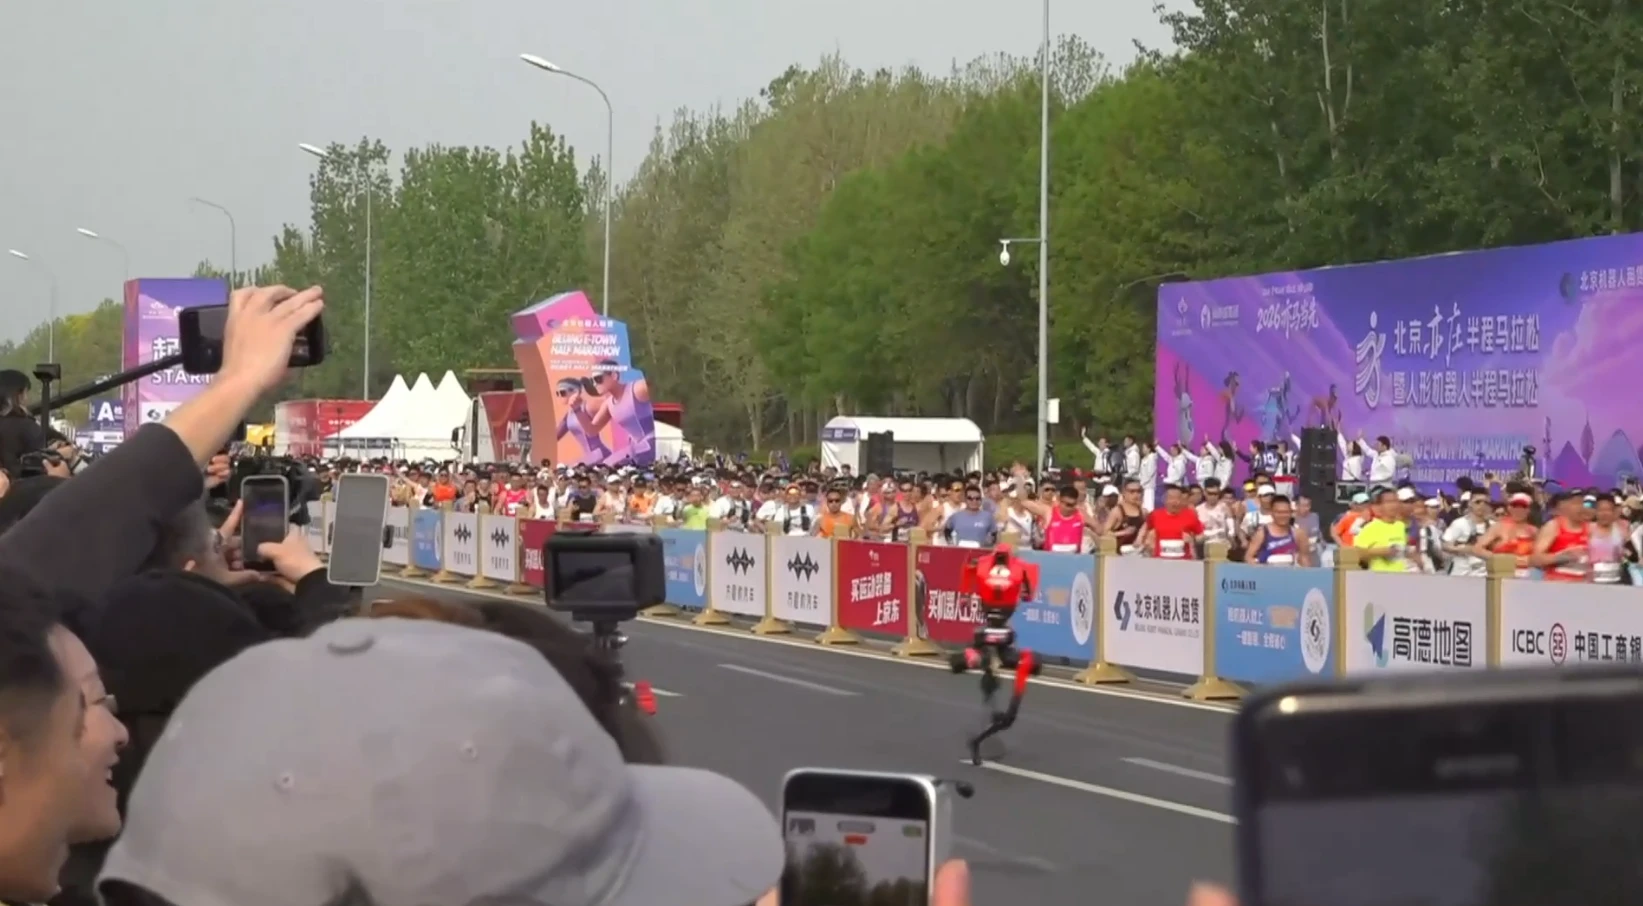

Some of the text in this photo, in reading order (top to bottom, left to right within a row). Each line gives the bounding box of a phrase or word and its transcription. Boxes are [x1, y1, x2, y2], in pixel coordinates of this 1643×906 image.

[573, 345, 621, 356] MARATHON
[1393, 368, 1539, 408] 暨人形机器人半程马拉松
[851, 571, 893, 603] 买运动装备
[872, 599, 901, 626] 上京东
[1135, 593, 1199, 624] 北京机器人租赁
[1393, 616, 1472, 667] 高德地图
[1512, 628, 1544, 655] ICBC
